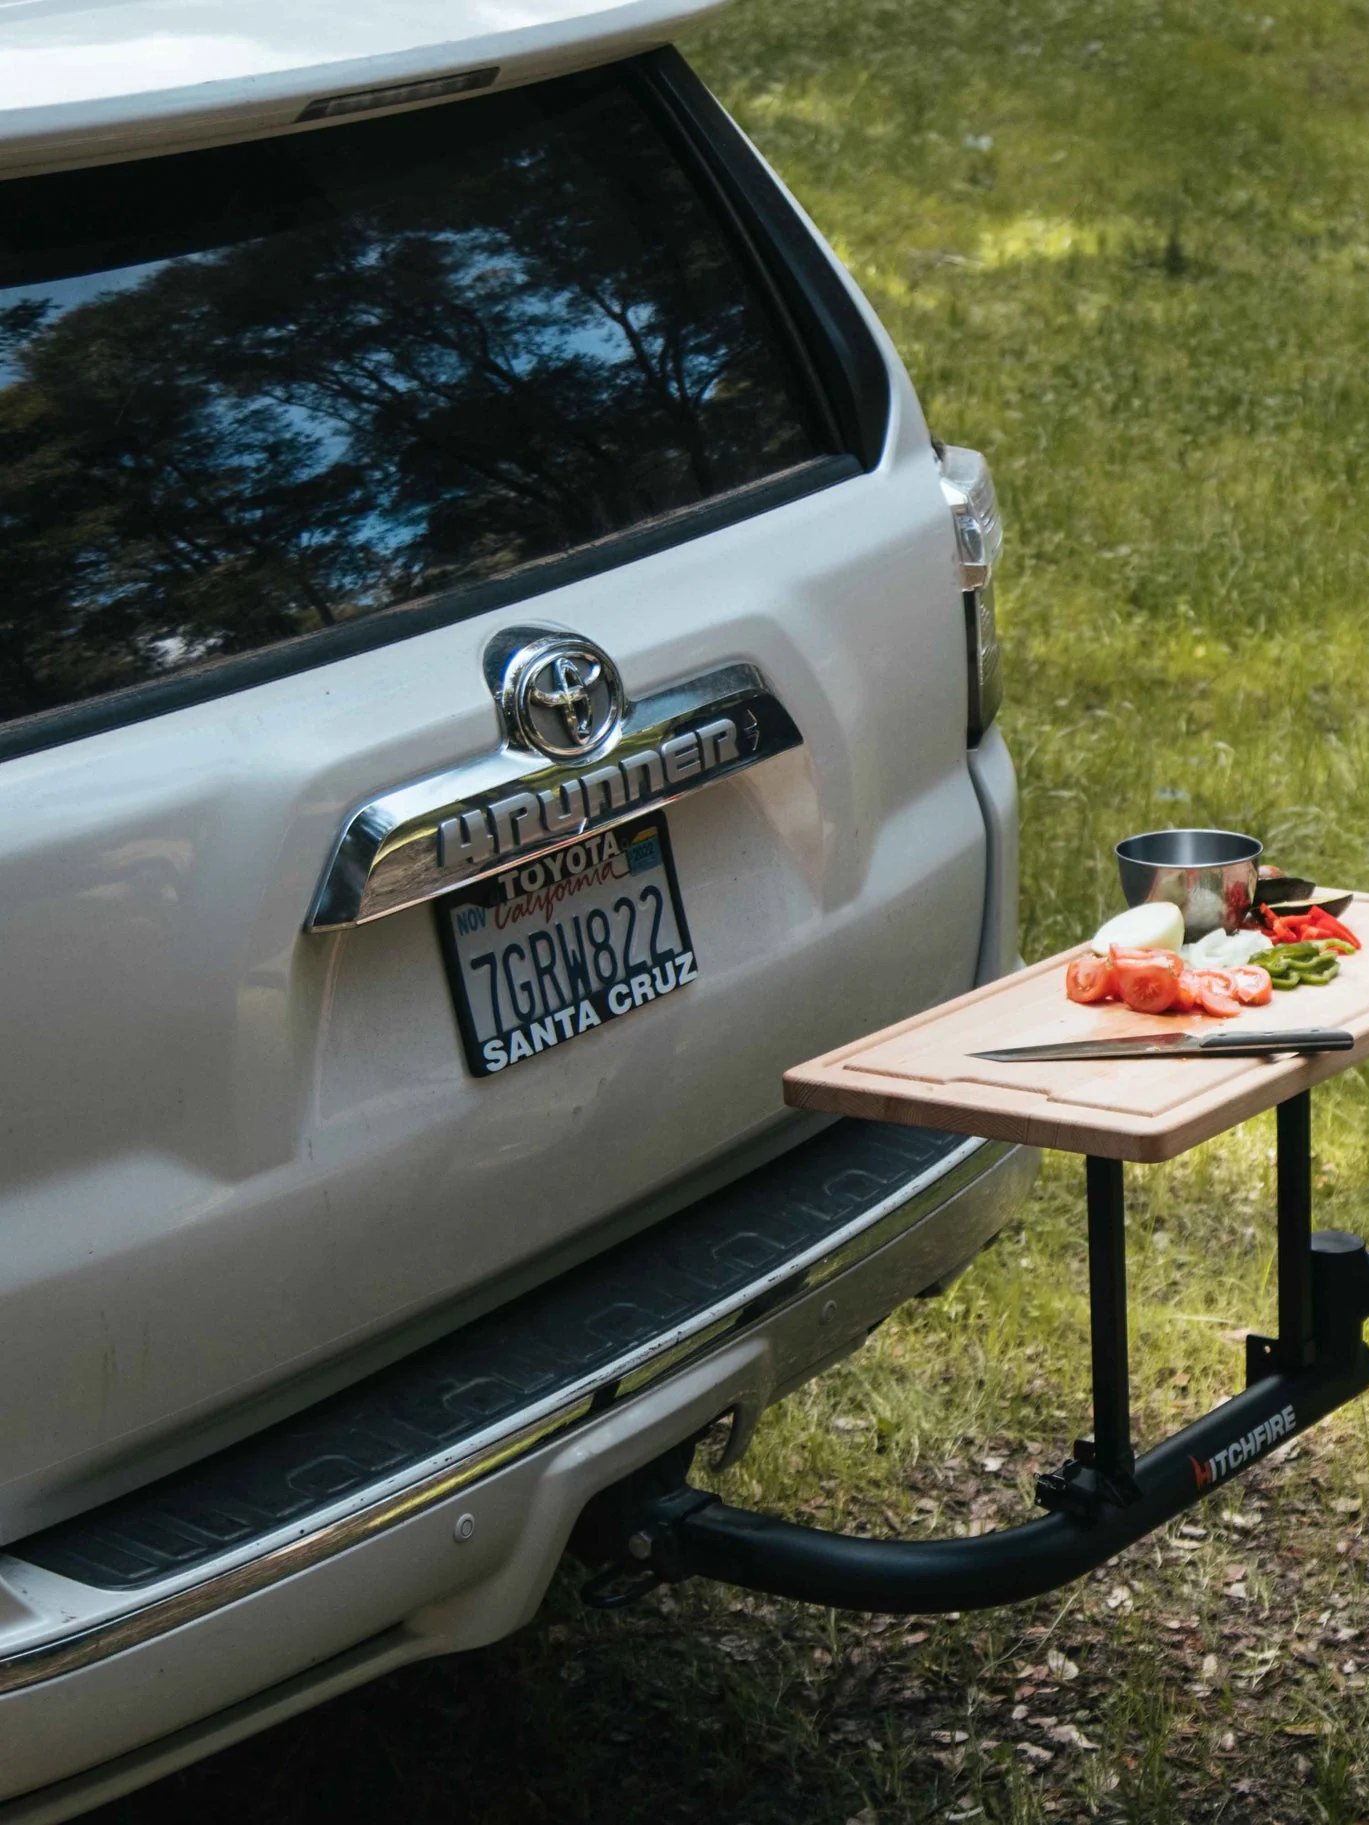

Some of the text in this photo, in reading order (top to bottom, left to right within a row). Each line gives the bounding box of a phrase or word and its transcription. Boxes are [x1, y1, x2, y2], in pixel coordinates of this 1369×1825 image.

[494, 860, 631, 930] California
[498, 829, 621, 900] TOYOTA
[457, 906, 486, 936] NOV
[470, 885, 676, 1038] 7GRW822
[482, 950, 699, 1074] SANTA CRUZ
[1188, 1404, 1298, 1489] HITCHFIRE
